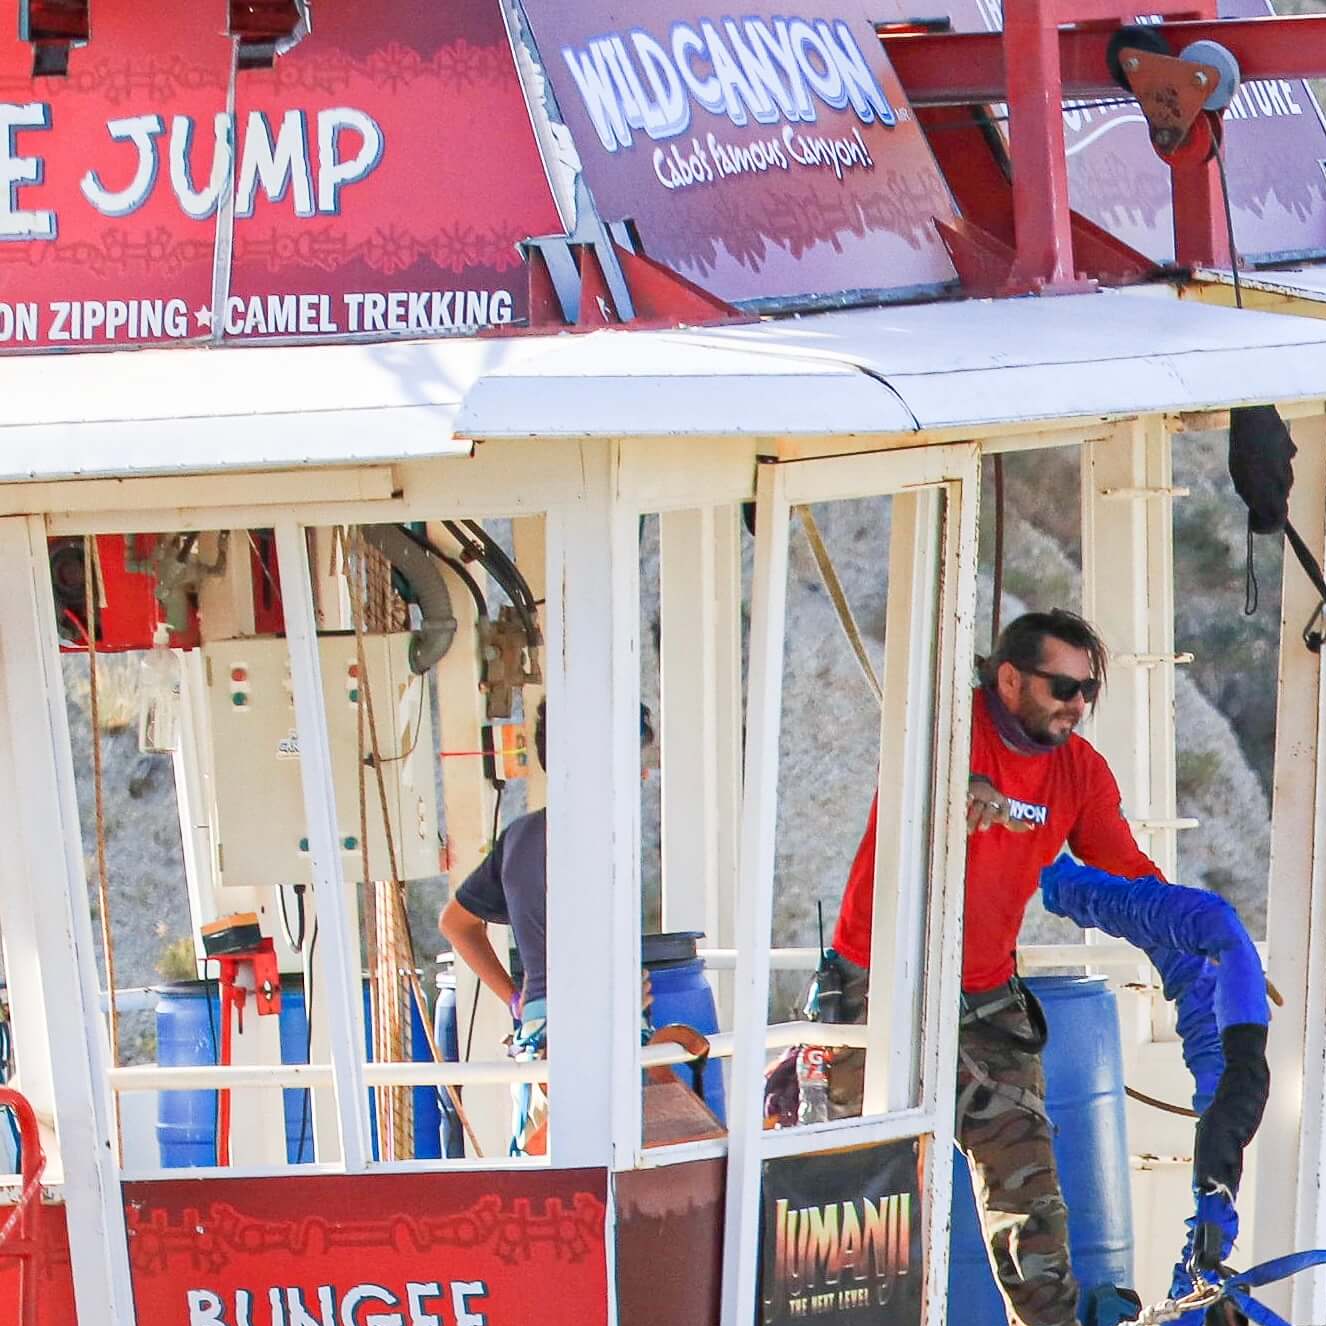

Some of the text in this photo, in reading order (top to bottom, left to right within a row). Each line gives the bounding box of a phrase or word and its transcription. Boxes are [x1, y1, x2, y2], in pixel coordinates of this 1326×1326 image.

[80, 106, 384, 219] JUMP
[653, 145, 714, 190] Cabo's
[782, 124, 874, 181] Canyon!
[48, 299, 188, 340] ZIPPING
[223, 295, 337, 335] CAMEL
[344, 290, 513, 332] TREKKING
[768, 1193, 911, 1304] JUMANJI
